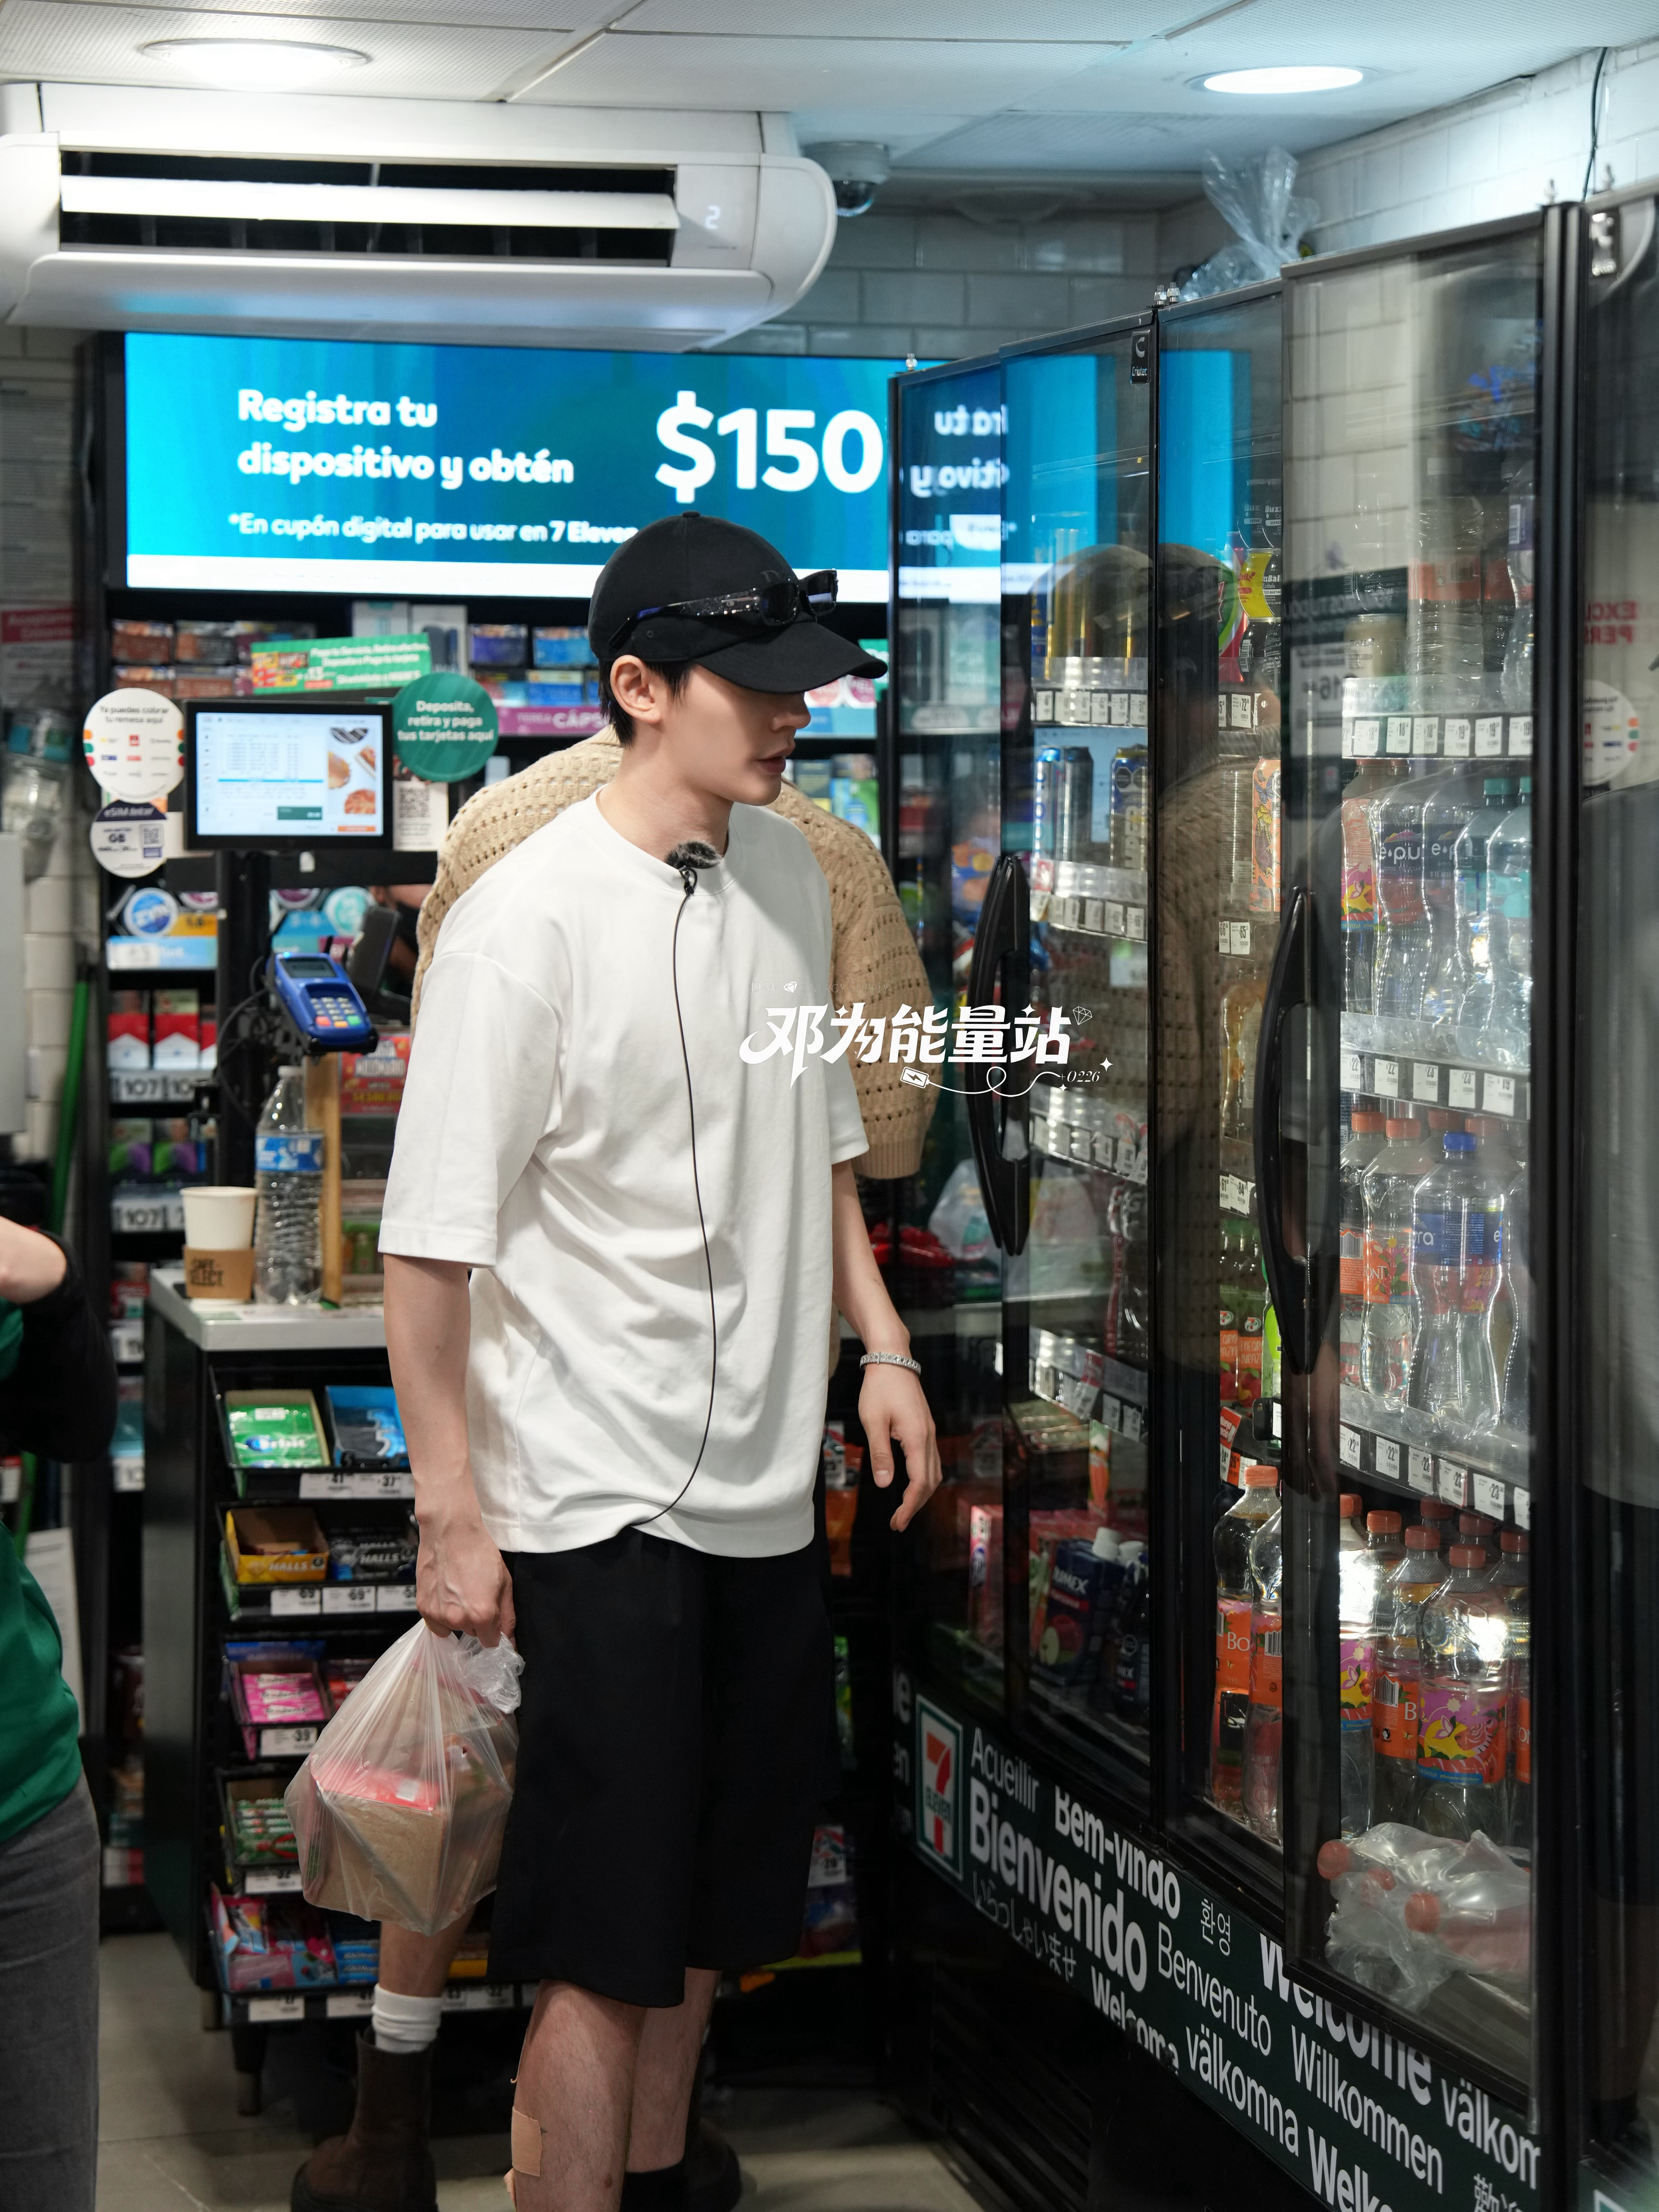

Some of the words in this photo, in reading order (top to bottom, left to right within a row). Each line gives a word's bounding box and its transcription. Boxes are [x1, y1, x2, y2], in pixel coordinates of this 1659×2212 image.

[238, 389, 390, 431] Registra
[397, 395, 439, 428] tu
[238, 442, 435, 484] dispositivo
[441, 457, 463, 490] y
[469, 448, 574, 483] obtén
[655, 390, 884, 504] $150
[271, 514, 340, 542] cupón
[342, 516, 411, 543] digital
[415, 524, 467, 544] para
[470, 523, 517, 542] usar
[520, 525, 548, 542] en
[408, 715, 442, 726] retira
[442, 717, 451, 729] y
[452, 717, 483, 729] paga
[416, 700, 474, 713] Deposita,
[397, 730, 417, 741] tus
[419, 730, 467, 744] tarjetas
[467, 729, 494, 743] aquí
[109, 833, 126, 843] GB
[360, 1553, 400, 1564] HALLS
[972, 1726, 1040, 1812] Acueillir
[1054, 1784, 1181, 1920] Bem-vindo
[970, 1776, 1148, 1993] Bienvenido
[1158, 1920, 1271, 2056] Benvenuto
[1185, 2022, 1299, 2157] välkomna
[1291, 2024, 1443, 2195] Willkommen
